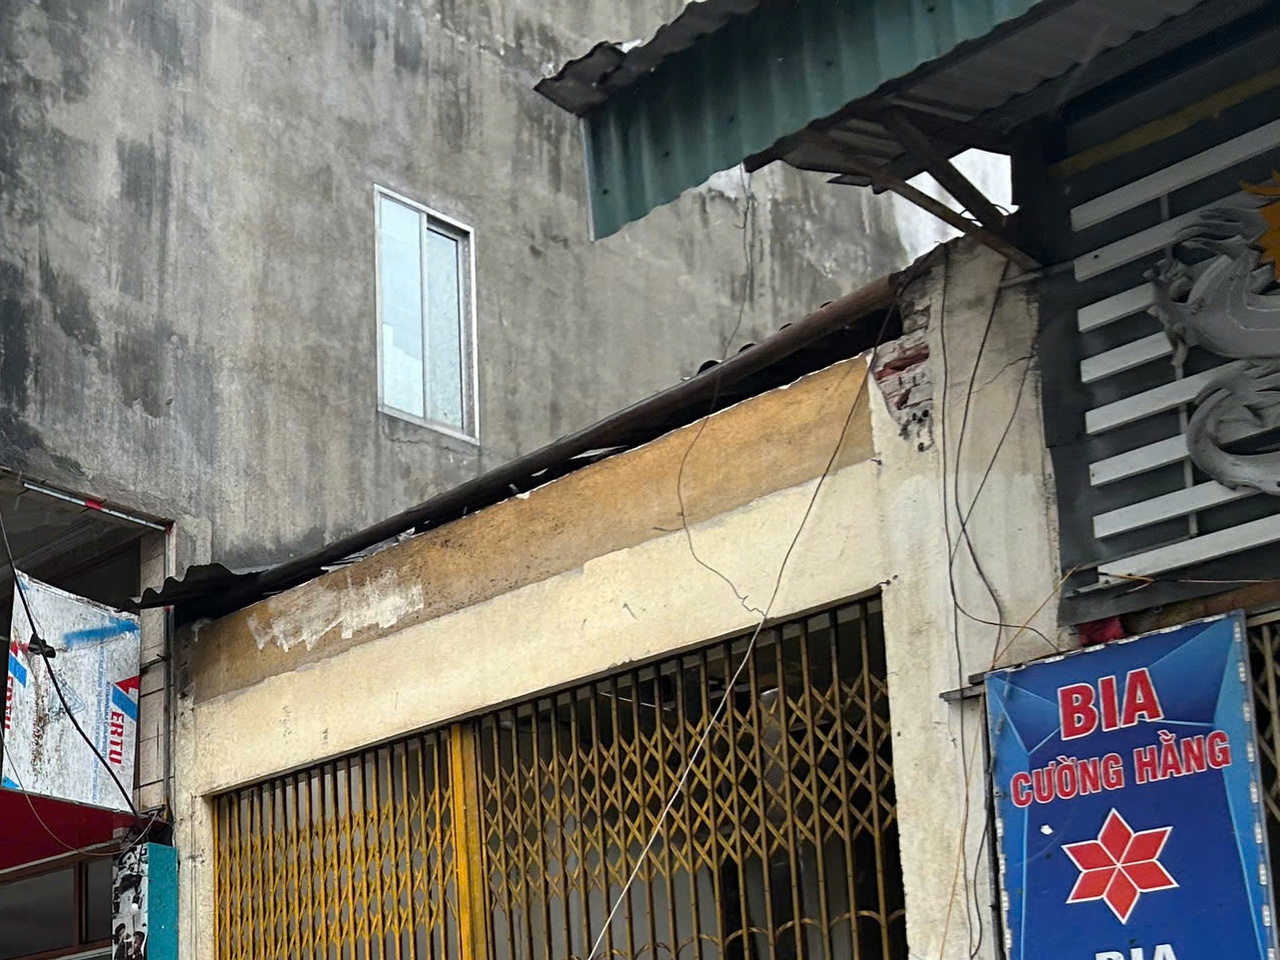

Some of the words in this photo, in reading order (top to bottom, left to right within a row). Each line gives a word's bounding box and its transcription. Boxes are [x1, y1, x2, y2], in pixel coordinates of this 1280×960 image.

[1057, 667, 1164, 742] BIA
[1010, 752, 1125, 808] CƯỜNG
[1135, 729, 1233, 786] HẰNG
